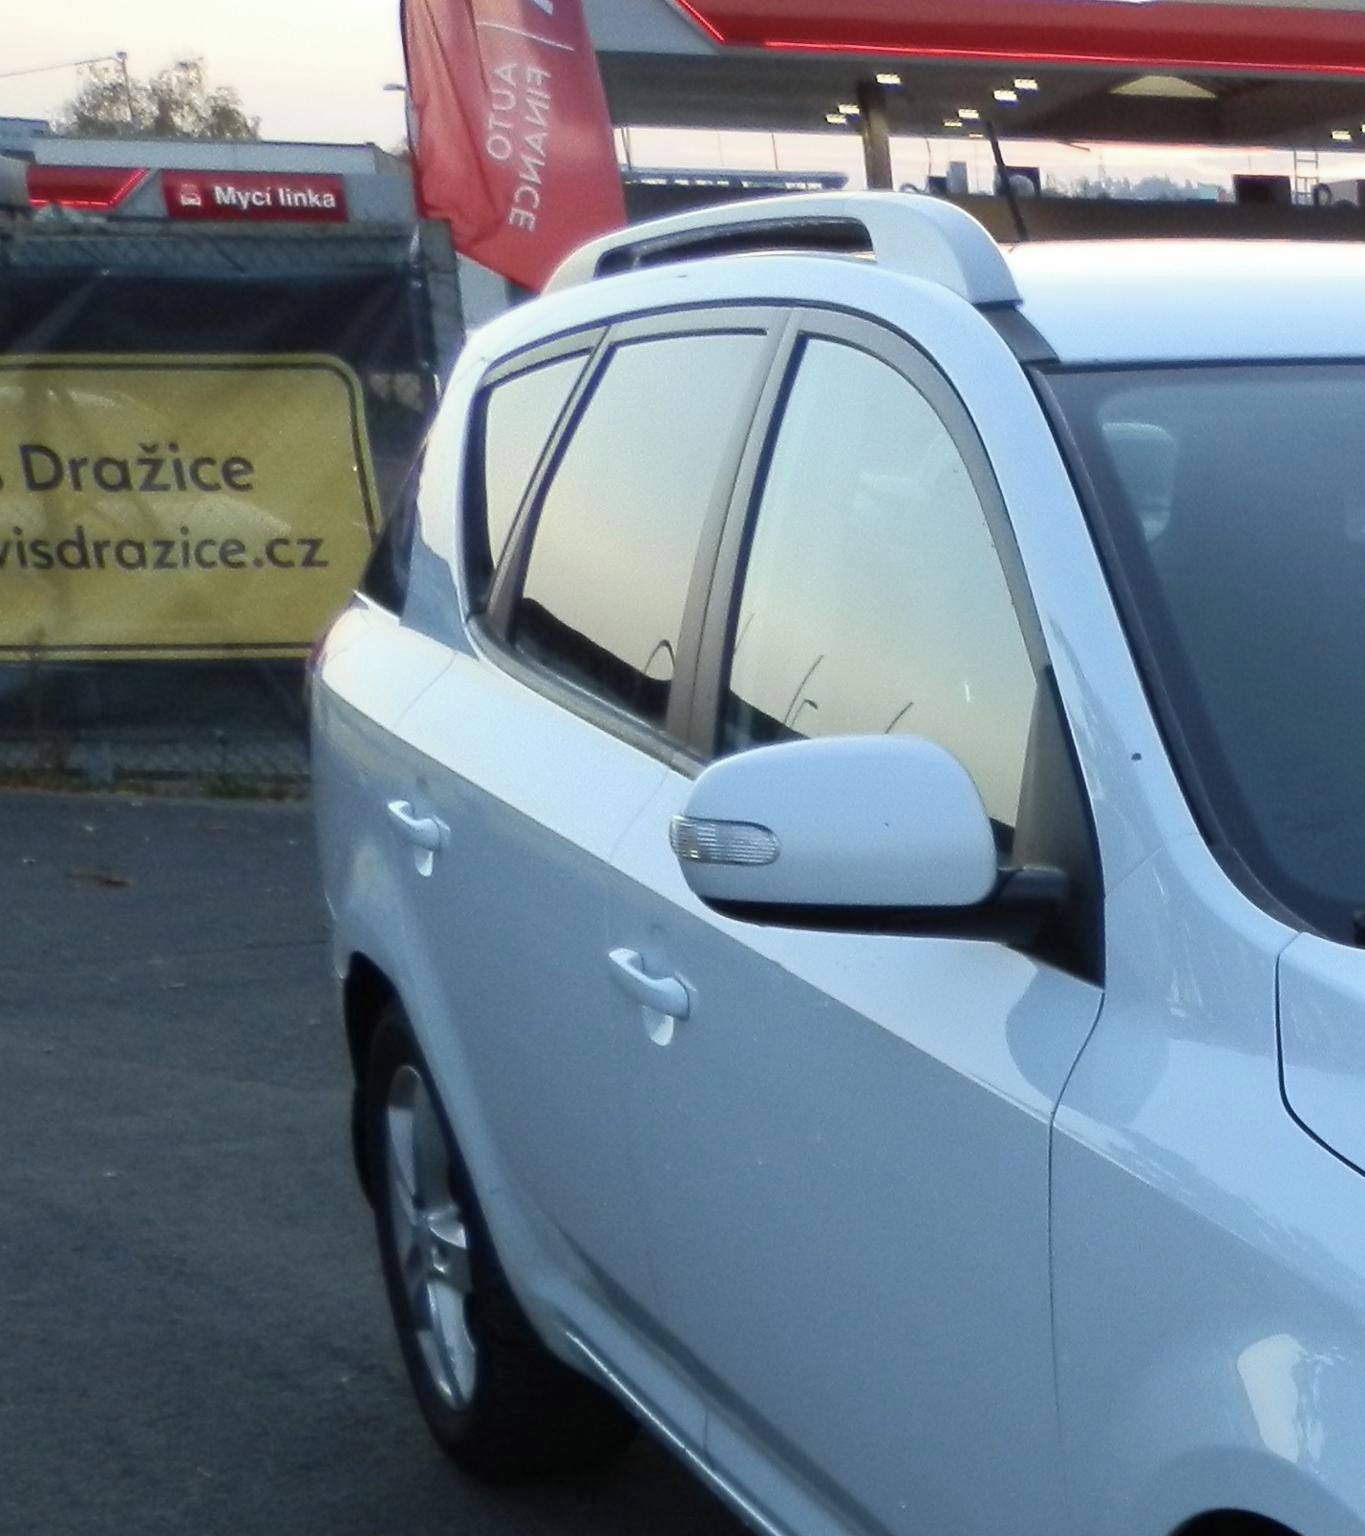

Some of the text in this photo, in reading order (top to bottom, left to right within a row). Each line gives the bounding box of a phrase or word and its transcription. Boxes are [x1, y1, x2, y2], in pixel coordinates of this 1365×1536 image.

[214, 185, 337, 211] Mycí linka
[18, 441, 255, 493] Dražice
